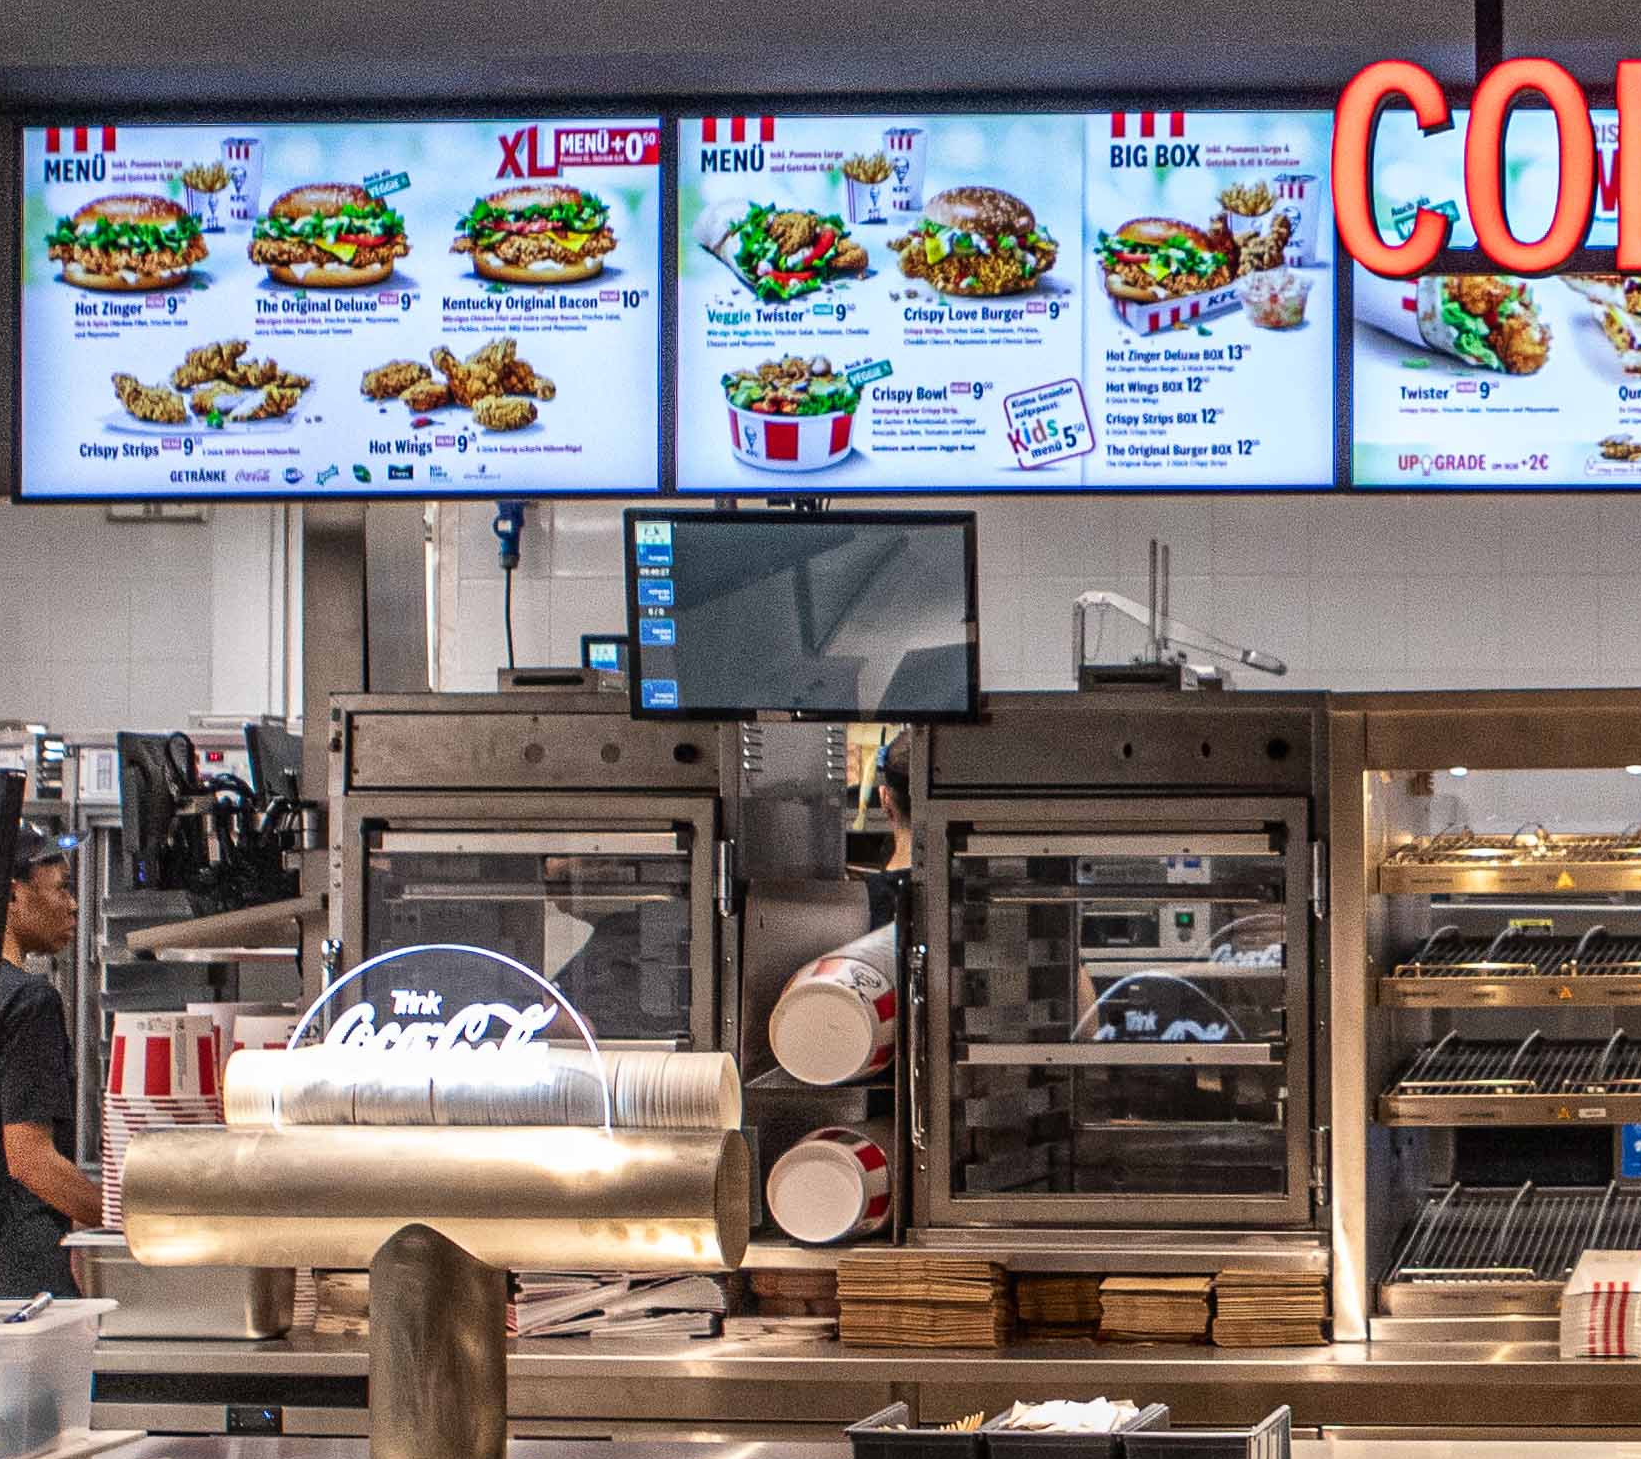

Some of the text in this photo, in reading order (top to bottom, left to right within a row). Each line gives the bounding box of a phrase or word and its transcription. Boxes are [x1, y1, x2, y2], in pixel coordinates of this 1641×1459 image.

[496, 124, 609, 179] XL MENÜ
[700, 143, 765, 173] MENÜ
[1110, 144, 1148, 168] BIG
[1154, 143, 1201, 168] BOX
[43, 152, 107, 183] MENÜ
[75, 300, 143, 318] Hot Zinger
[255, 297, 378, 315] The Original Deluxe
[442, 295, 599, 312] Kentucky Original Bacon
[707, 308, 805, 325] Veggie Twister
[903, 306, 1025, 324] Crispy Love Burger
[1106, 348, 1224, 363] Hot Zinger Deluxe BOX
[871, 385, 948, 403] Crispy Bowl
[1106, 381, 1184, 395] Hot Wings BOX
[1400, 385, 1449, 400] Twister
[1106, 412, 1198, 427] Crispy Strips BOX
[1006, 418, 1059, 455] Kids
[79, 442, 159, 461] Crispy Strips
[369, 439, 433, 457] Hot Wings
[1030, 440, 1063, 459] menü
[1106, 444, 1233, 458] The Original Burger BOX
[169, 467, 227, 483] GETRÄNKE
